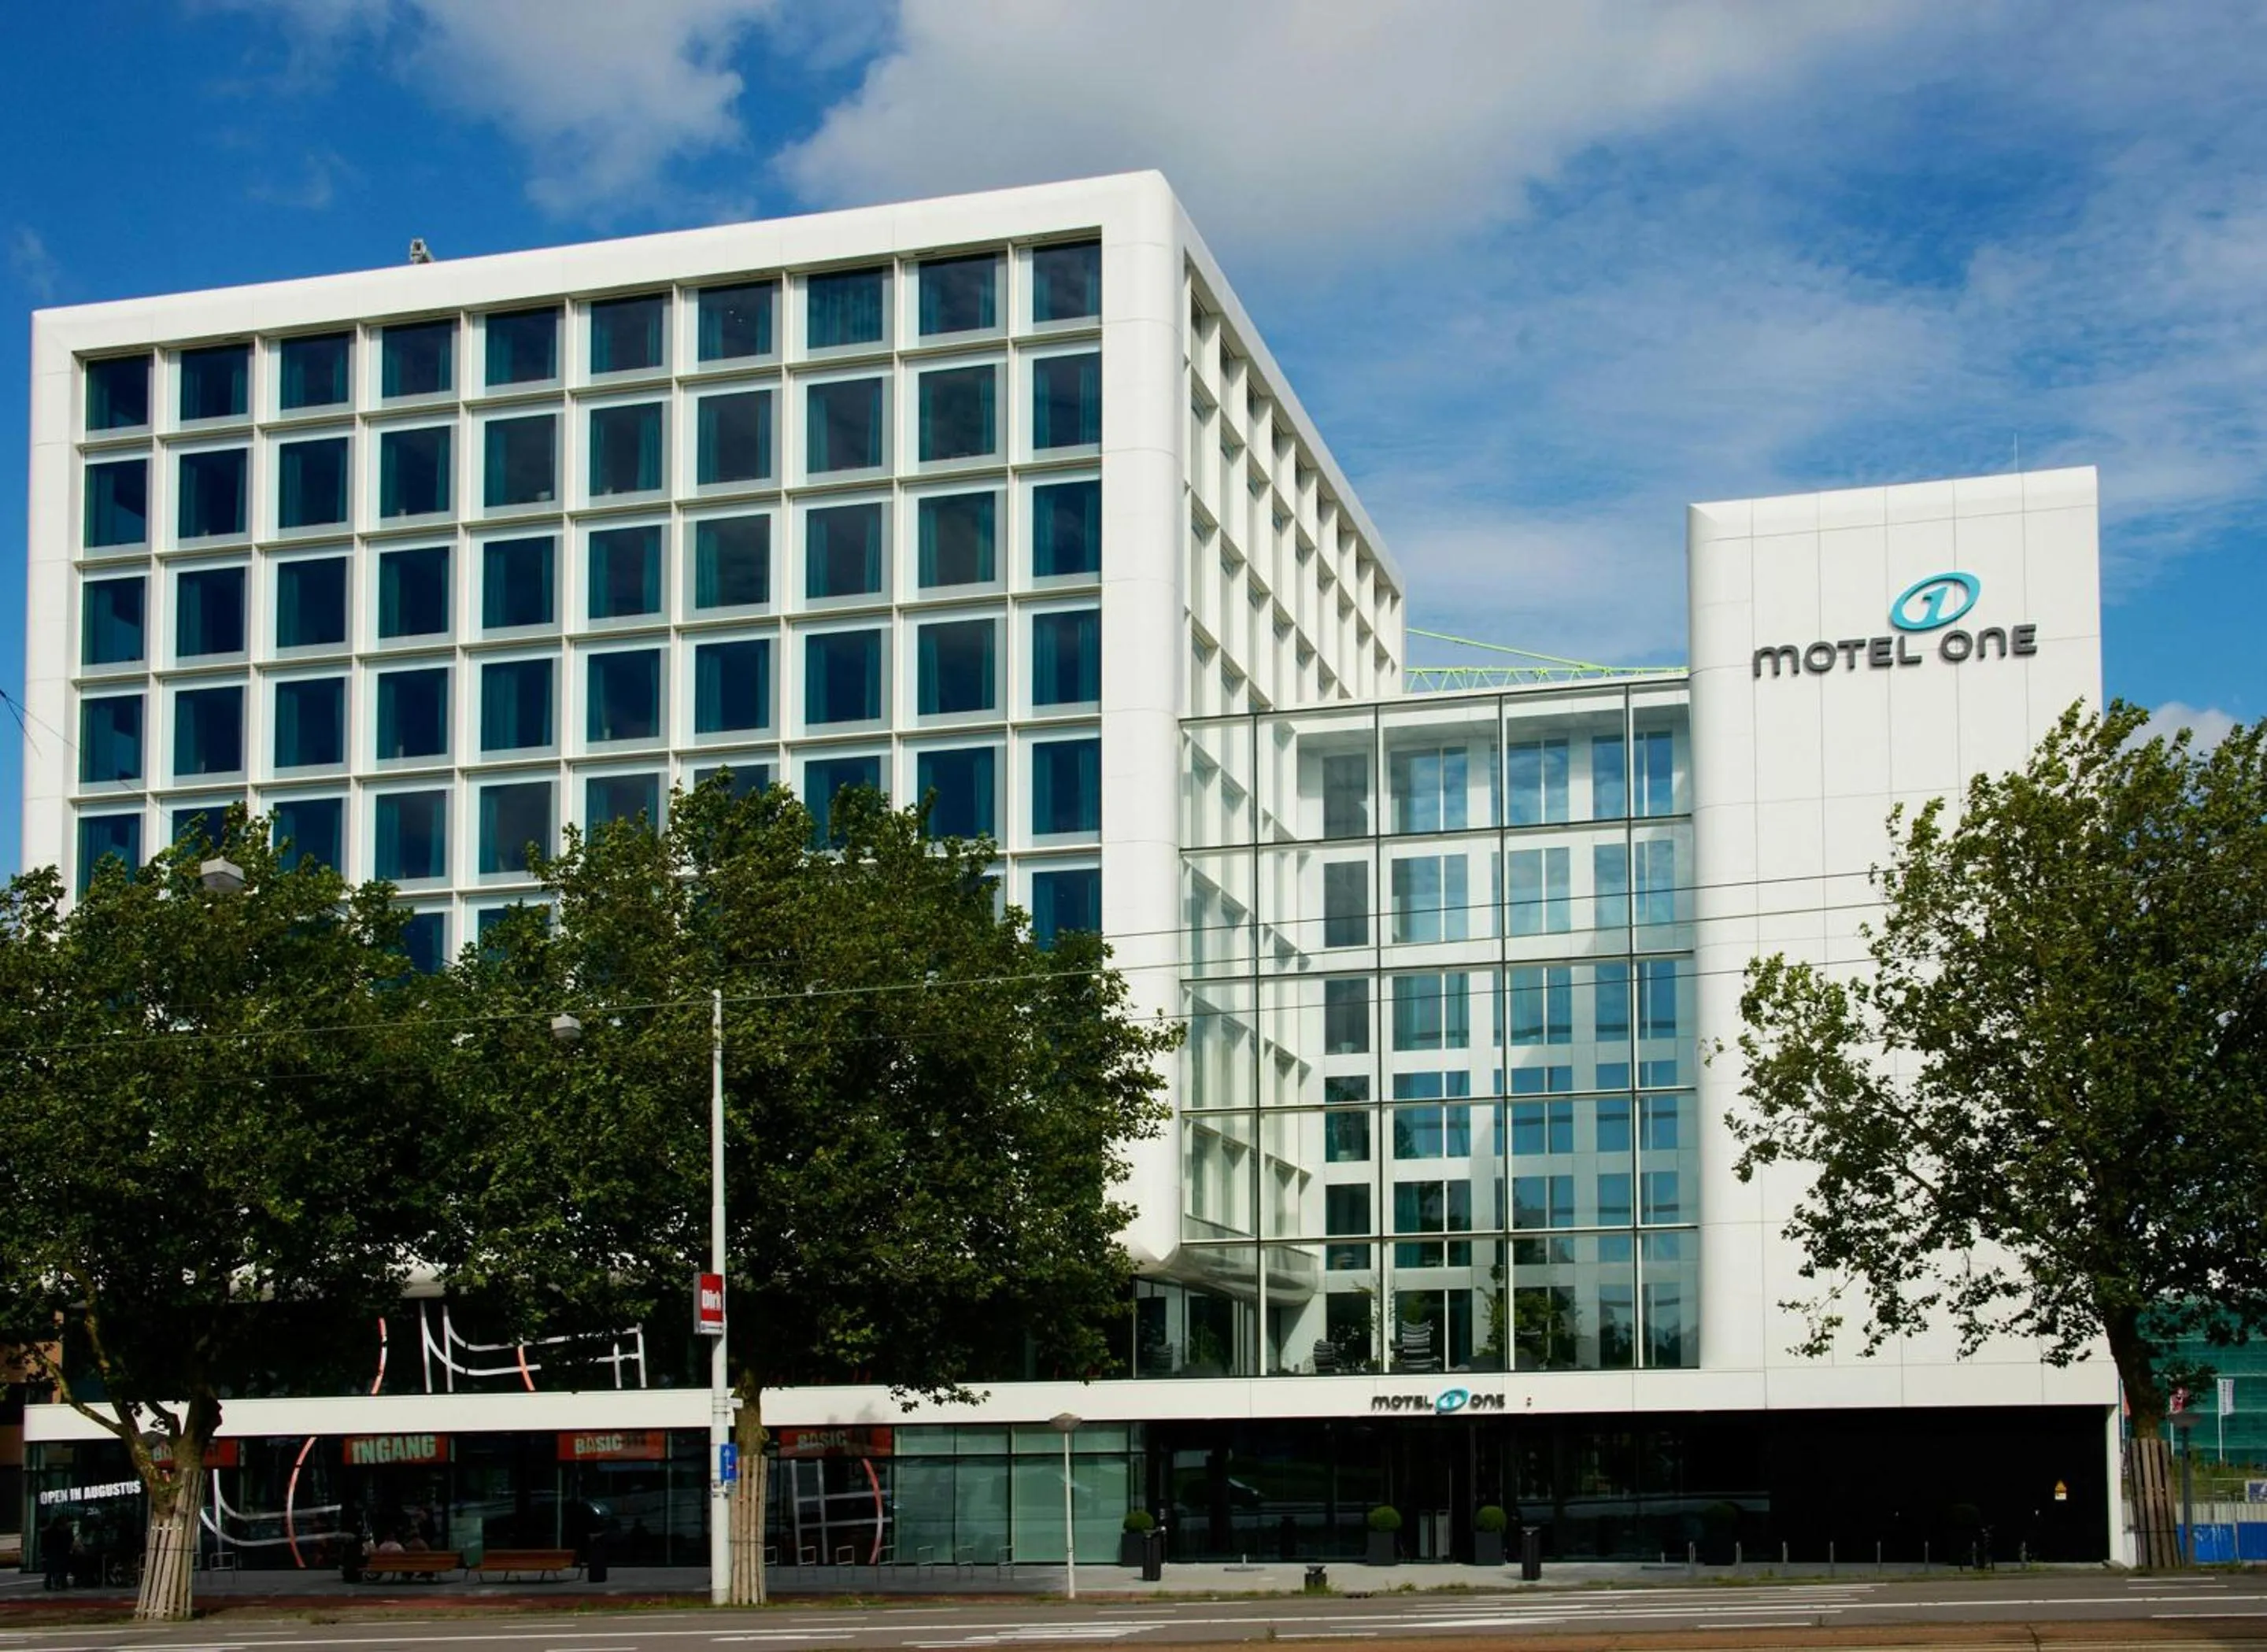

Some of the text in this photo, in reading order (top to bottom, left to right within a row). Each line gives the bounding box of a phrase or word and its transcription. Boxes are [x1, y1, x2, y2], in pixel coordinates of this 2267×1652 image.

[1752, 624, 2038, 678] MOTEL ONE
[1371, 1395, 1433, 1411] MOTEL
[1470, 1393, 1506, 1409] ONE
[352, 1435, 436, 1464] INGANG
[575, 1433, 623, 1454] BASIC
[40, 1480, 142, 1505] OPEN IN AUGUSTUS
